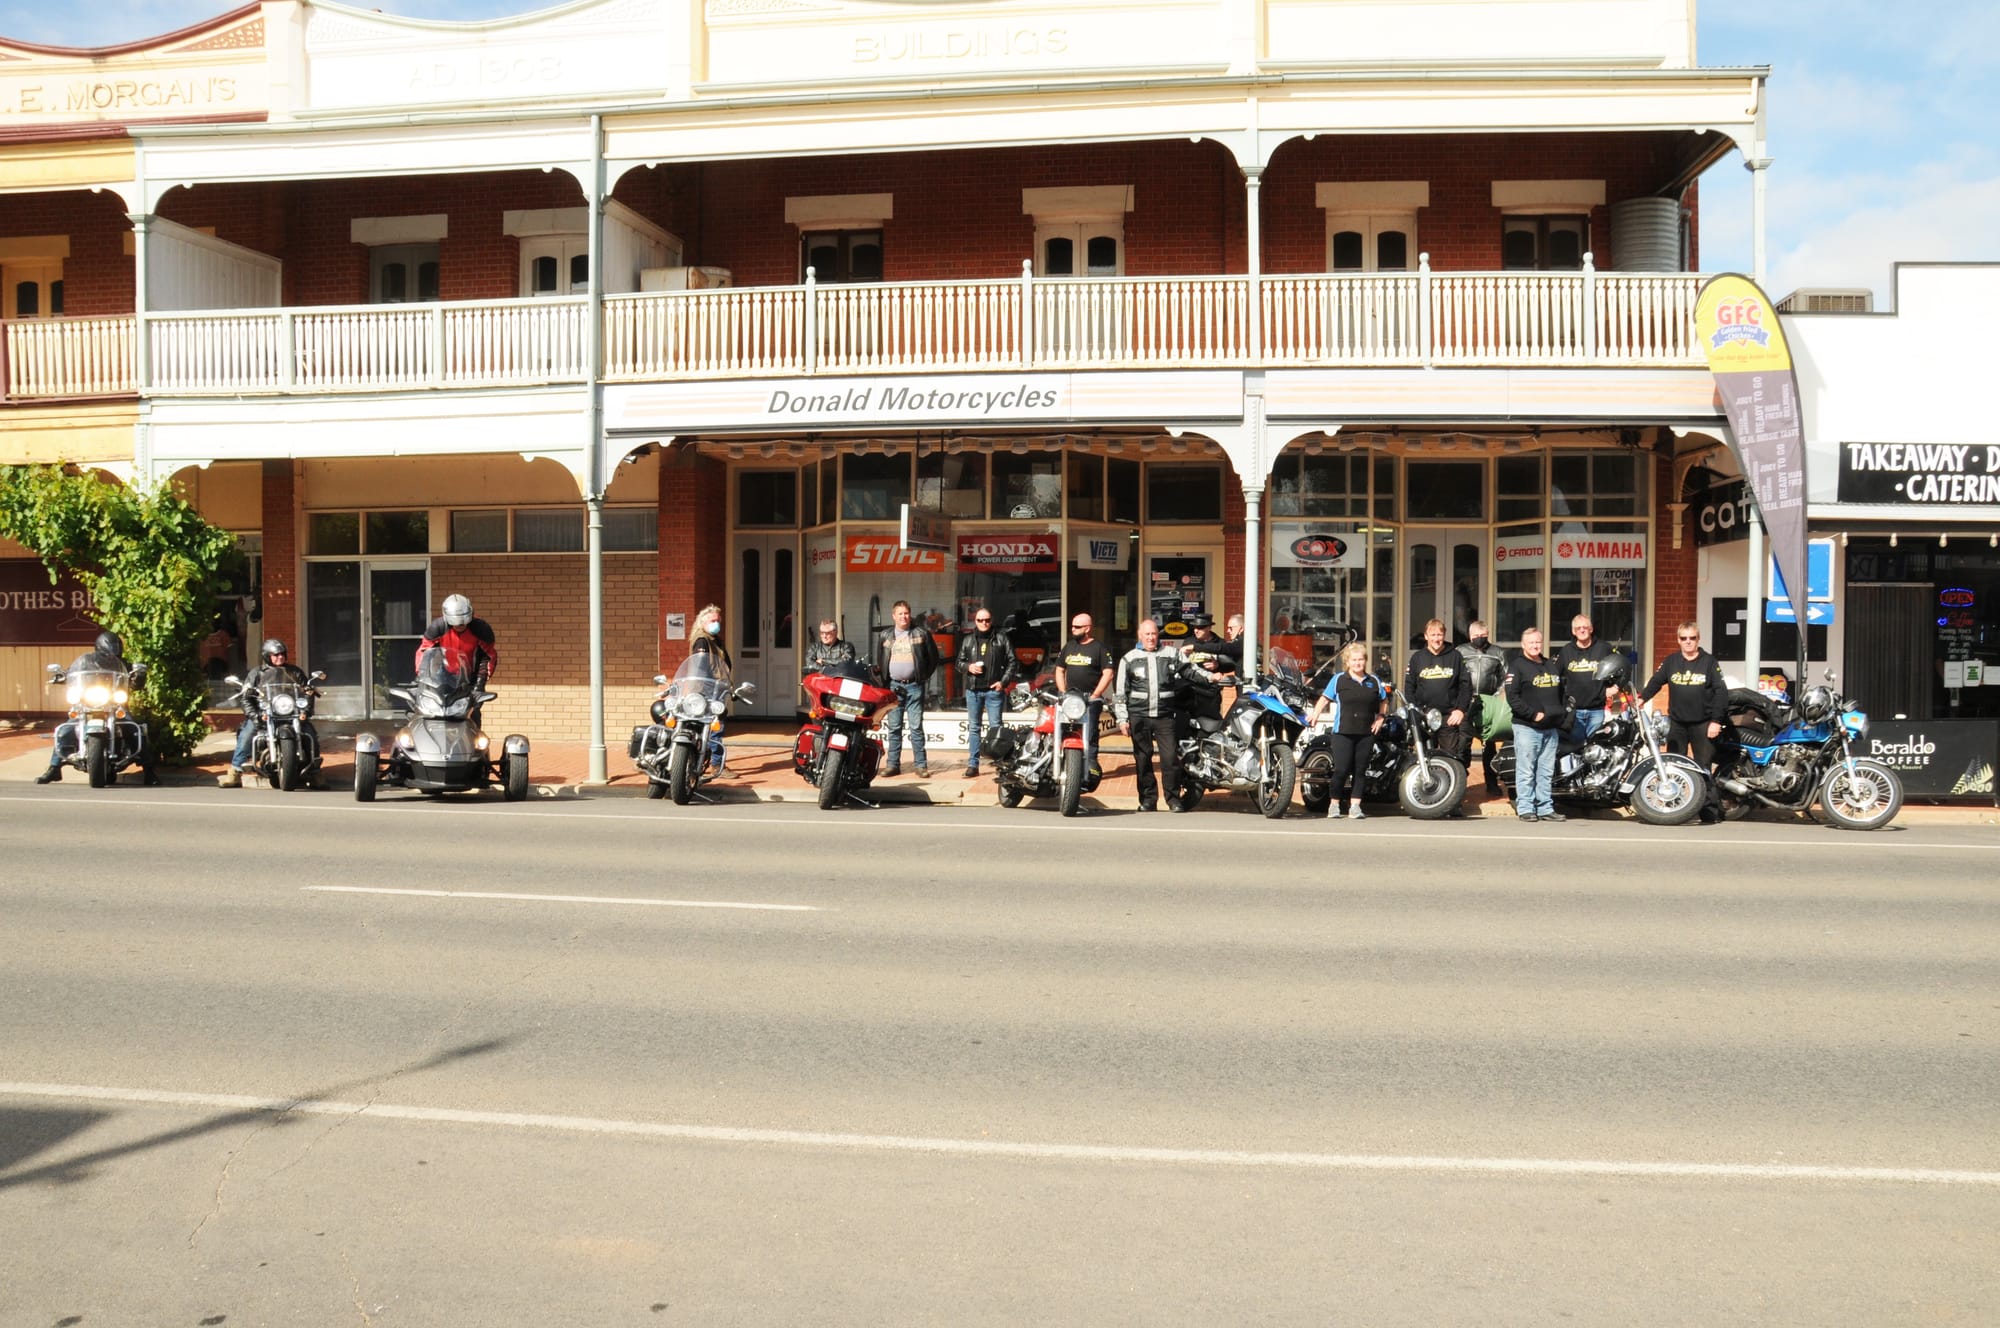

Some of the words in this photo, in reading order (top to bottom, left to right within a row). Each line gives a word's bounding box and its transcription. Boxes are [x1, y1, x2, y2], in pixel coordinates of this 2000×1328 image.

[852, 26, 1068, 63] BUILDINGS
[479, 56, 562, 84] 1908
[66, 77, 237, 111] MORGAN'S
[1718, 305, 1760, 325] GFC
[1752, 376, 1763, 389] GO
[768, 387, 872, 413] Donald
[878, 384, 1058, 414] Motorcycles
[1753, 390, 1763, 403] TO
[1754, 405, 1765, 433] READY
[1847, 443, 1969, 472] TAKEAWAY
[1777, 472, 1788, 500] READY
[850, 544, 937, 564] STIHL
[960, 543, 1053, 556] HONDA
[1296, 540, 1339, 557] COX
[1508, 547, 1544, 558] CFMOTO
[1576, 541, 1644, 559] YAMAHA
[977, 556, 1000, 564] POWER
[1002, 556, 1035, 564] EQUIPMENT
[1603, 570, 1632, 579] ATOM
[1870, 734, 1936, 755] Beraldo
